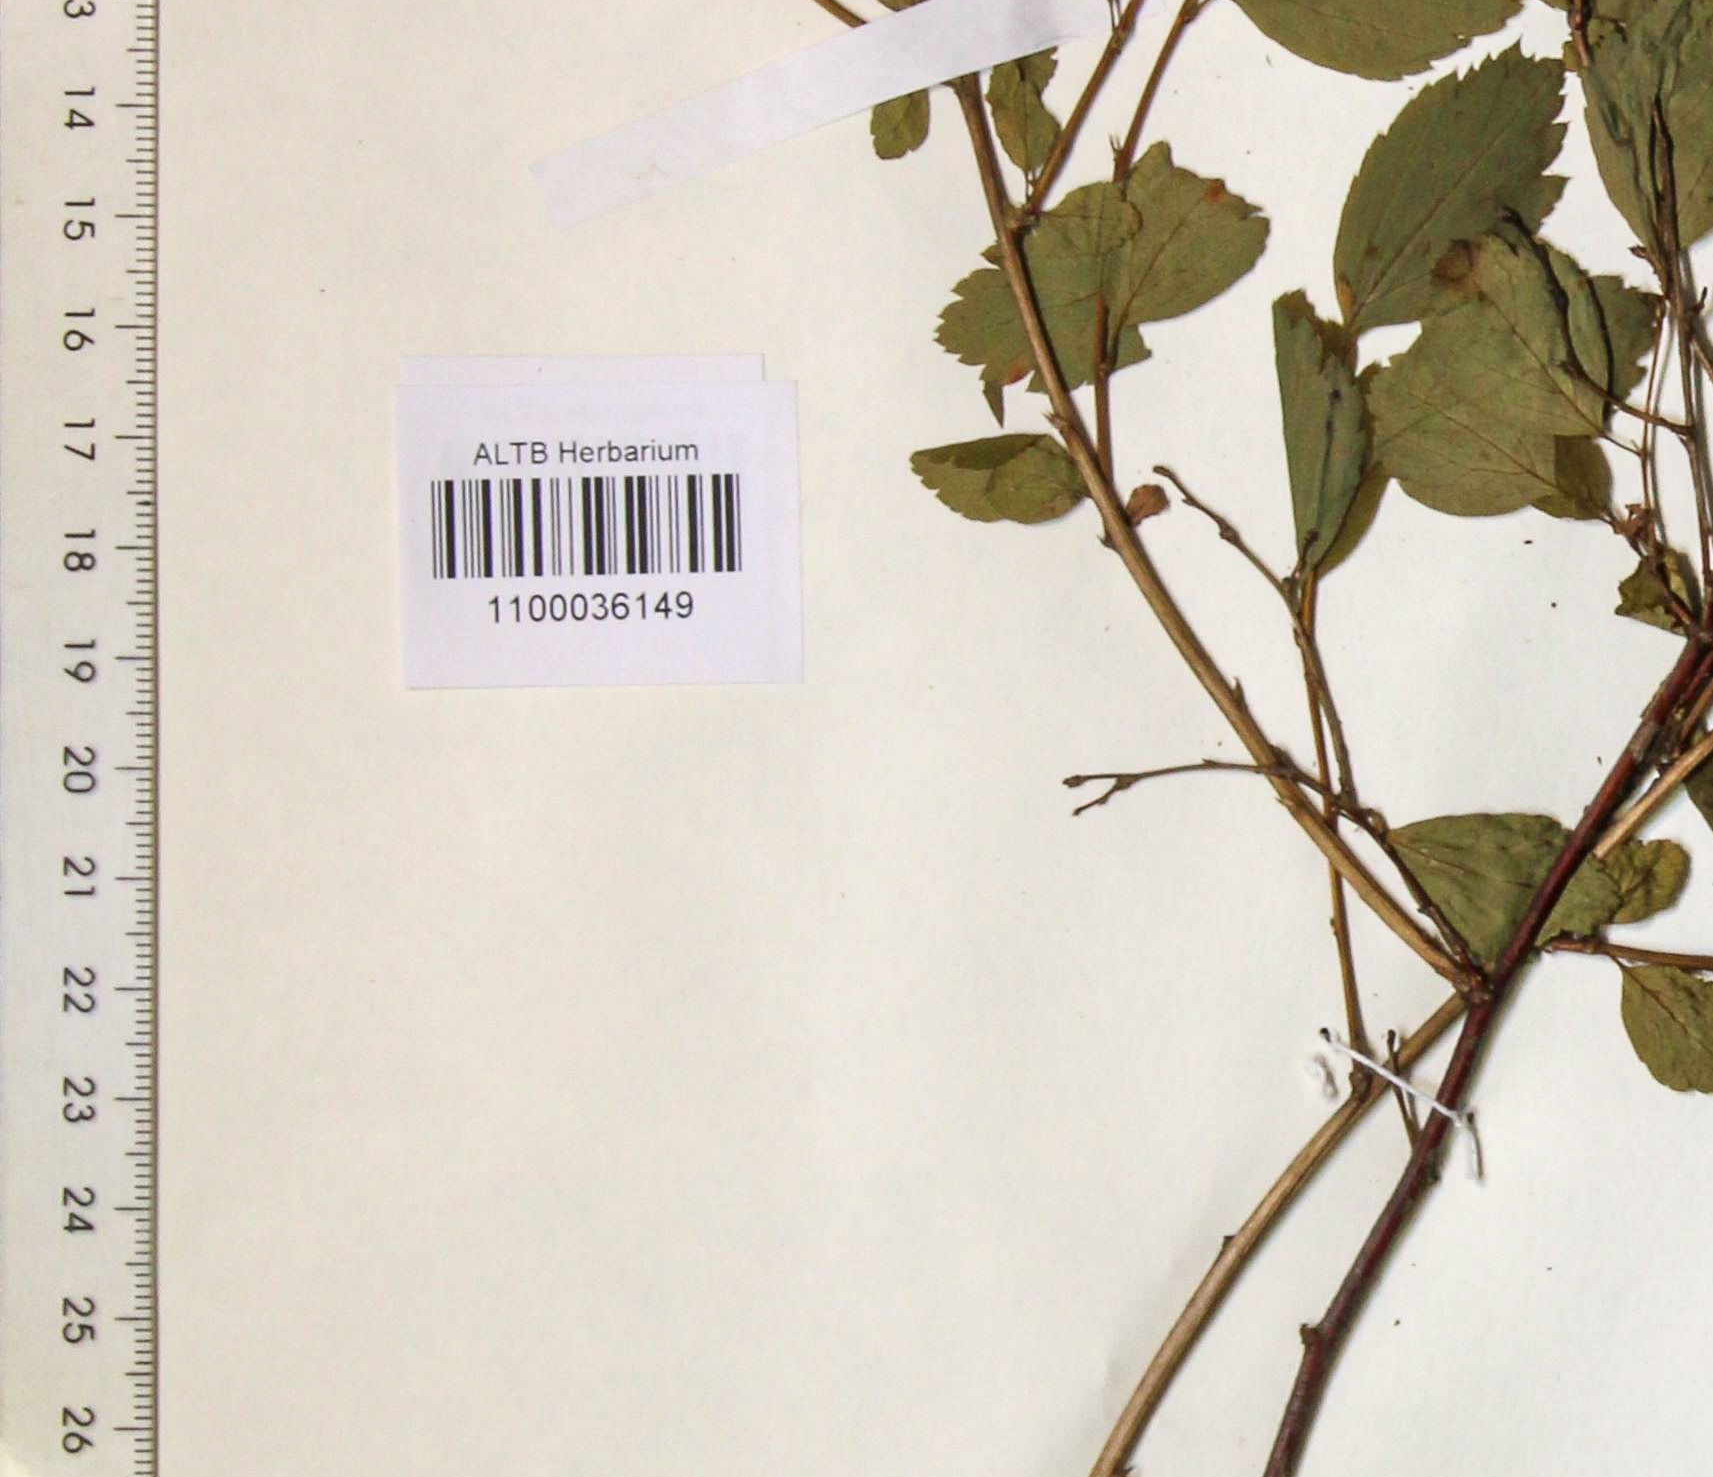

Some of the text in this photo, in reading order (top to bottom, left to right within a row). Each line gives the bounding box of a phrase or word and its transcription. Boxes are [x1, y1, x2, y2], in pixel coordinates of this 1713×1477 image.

[63, 86, 96, 131] 14
[62, 197, 96, 242] 15
[62, 307, 96, 352] 16
[63, 417, 97, 462] 17
[473, 439, 700, 465] ALTB Herbarium
[62, 528, 97, 573] 18
[488, 590, 694, 624] 1100036149
[63, 638, 98, 684] 19
[62, 745, 99, 796] 20
[62, 855, 98, 897] 21
[62, 966, 98, 1015] 22
[61, 1075, 98, 1124] 23
[61, 1186, 97, 1235] 24
[61, 1296, 98, 1345] 25
[61, 1406, 97, 1455] 26
